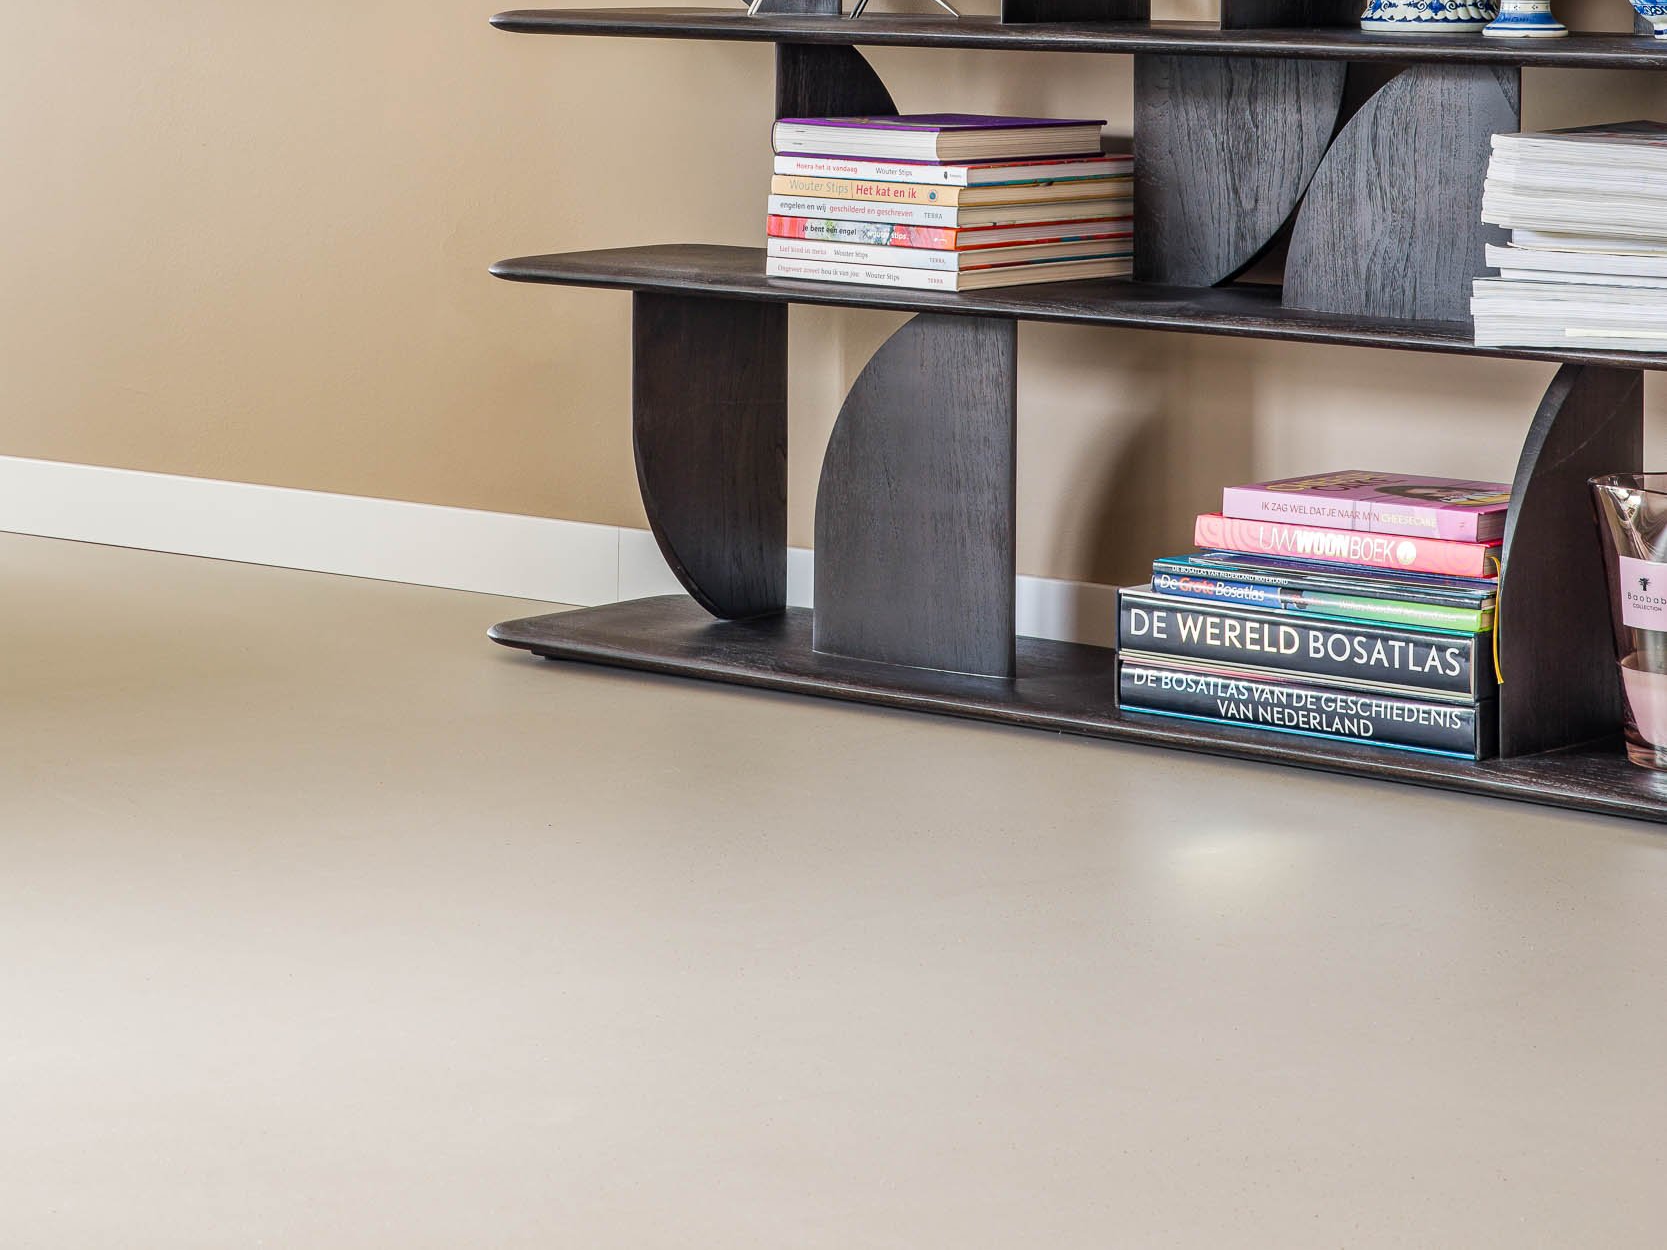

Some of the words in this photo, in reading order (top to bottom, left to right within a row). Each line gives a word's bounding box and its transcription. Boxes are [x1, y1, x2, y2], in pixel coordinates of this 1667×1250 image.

[796, 161, 814, 170] Hoera
[832, 166, 858, 174] vandaag
[898, 169, 913, 177] Stips
[789, 180, 823, 191] Wouter
[825, 182, 849, 196] Stips
[856, 184, 873, 196] Het
[875, 185, 891, 197] kat
[893, 189, 905, 198] en
[908, 188, 917, 199] ik
[780, 202, 806, 210] engelen
[817, 204, 827, 213] wij
[829, 205, 866, 214] geschilderd
[877, 209, 913, 217] geschreven
[840, 228, 857, 236] engel
[865, 271, 885, 279] Wouter
[1261, 502, 1270, 510] IK
[1271, 503, 1288, 512] ZAG
[1290, 505, 1309, 514] WEL
[1310, 507, 1326, 516] DAT
[1326, 509, 1337, 517] JE
[1338, 509, 1361, 520] NAAR
[1159, 574, 1177, 590] De
[1179, 576, 1216, 595] Grote
[1215, 581, 1265, 601] Bosatlas
[1627, 592, 1667, 605] Baobab
[1632, 603, 1662, 611] COLLECTION
[1130, 608, 1167, 639] DE
[1176, 613, 1300, 655] WERELD
[1308, 630, 1461, 677] BOSATLAS
[1134, 667, 1157, 687] DE
[1161, 670, 1249, 700] BOSATLAS
[1252, 684, 1288, 704] VAN
[1293, 691, 1317, 709] DE
[1321, 693, 1462, 729] GESCHIEDENIS
[1217, 699, 1254, 721] VAN
[1258, 704, 1374, 737] NEDERLAND
